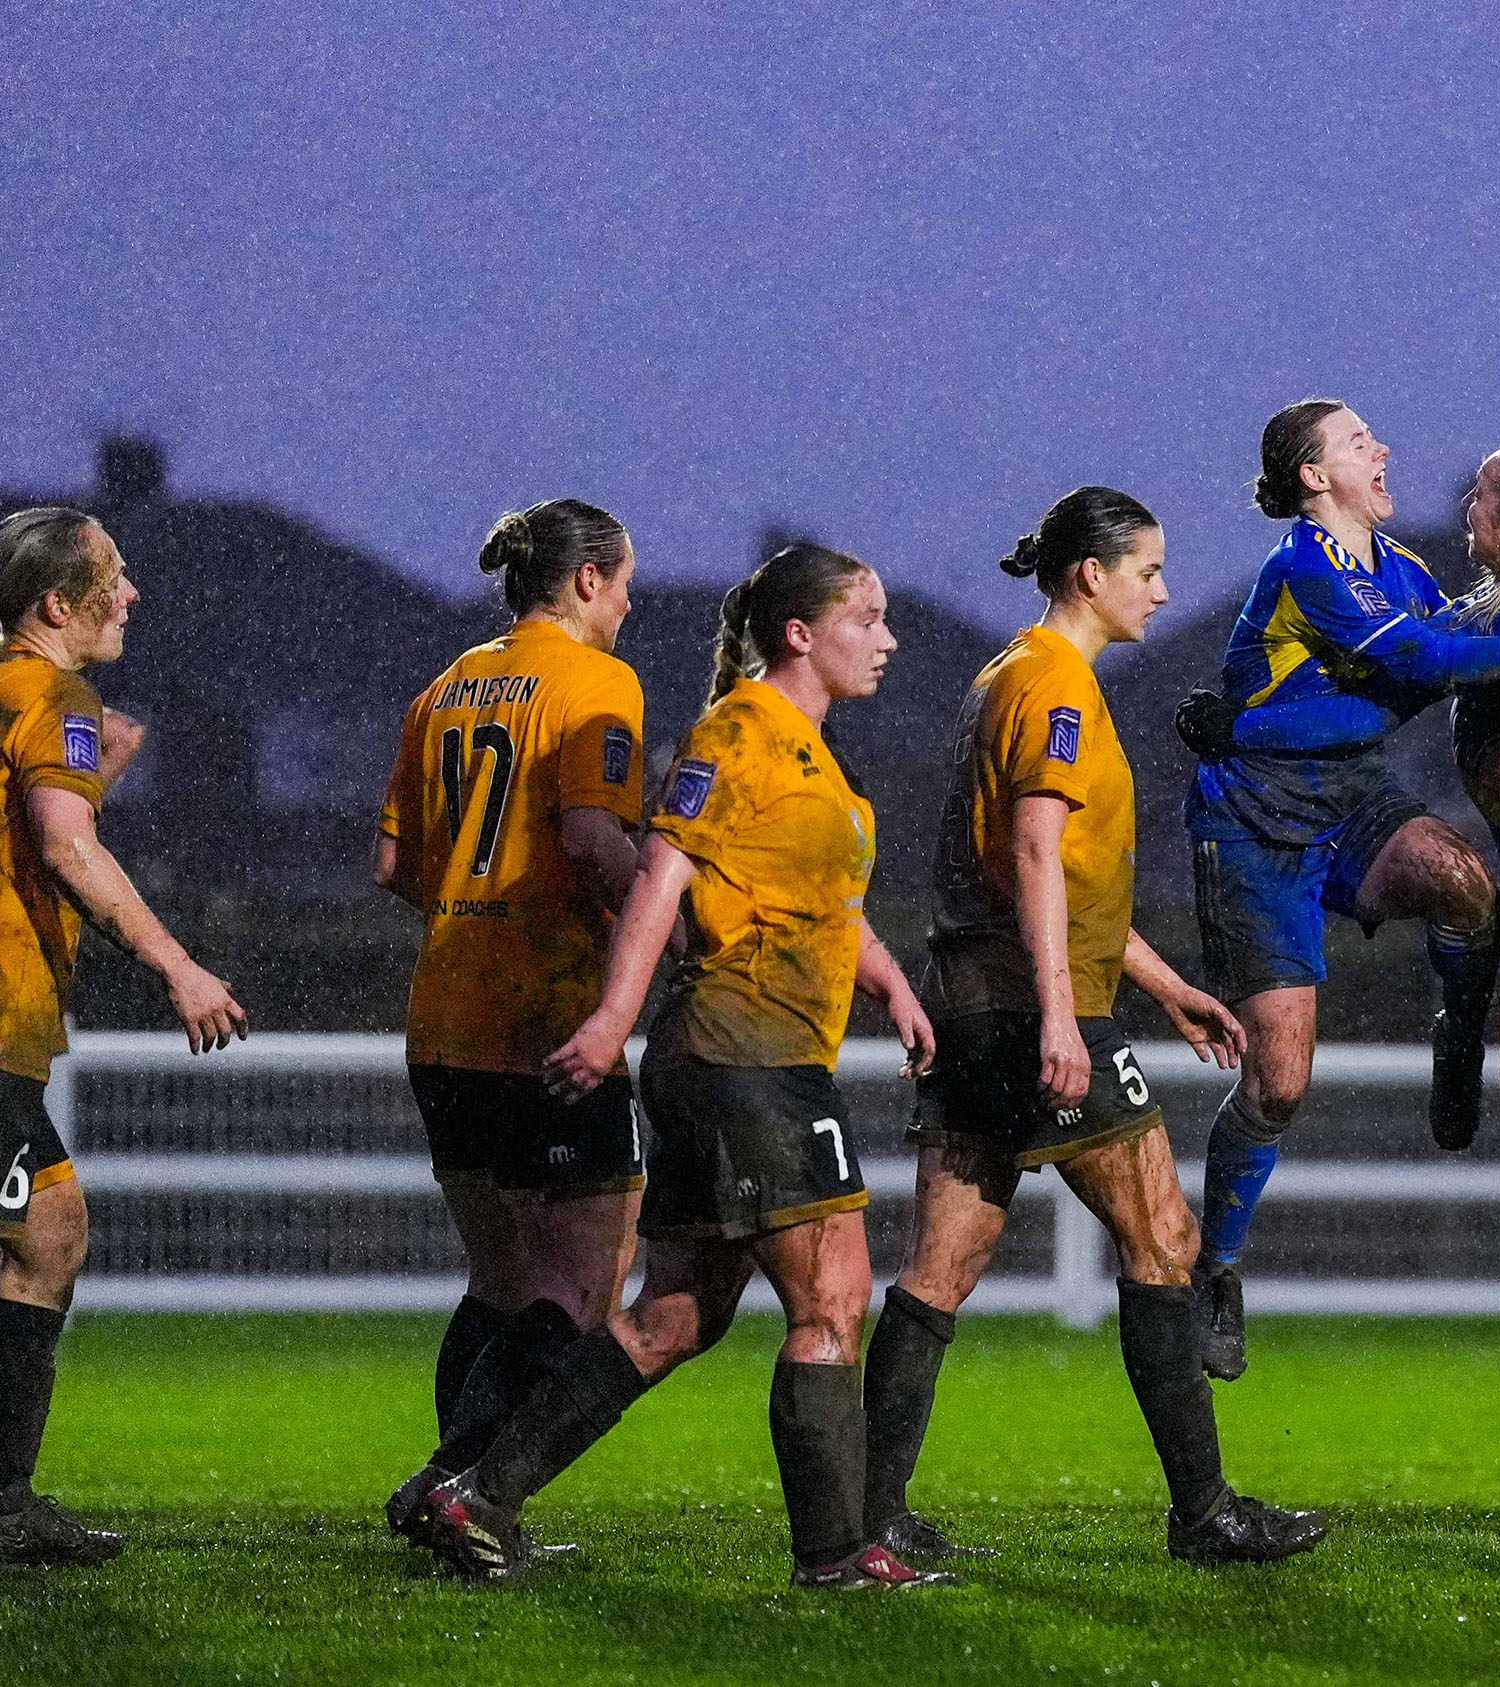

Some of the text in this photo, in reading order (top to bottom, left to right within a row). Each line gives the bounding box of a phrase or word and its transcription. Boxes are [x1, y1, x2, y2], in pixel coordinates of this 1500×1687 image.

[434, 675, 541, 711] JAMIESON
[440, 722, 515, 877] 17
[1112, 1046, 1150, 1106] 5
[0, 1143, 30, 1210] 6
[812, 1117, 850, 1181] 7
